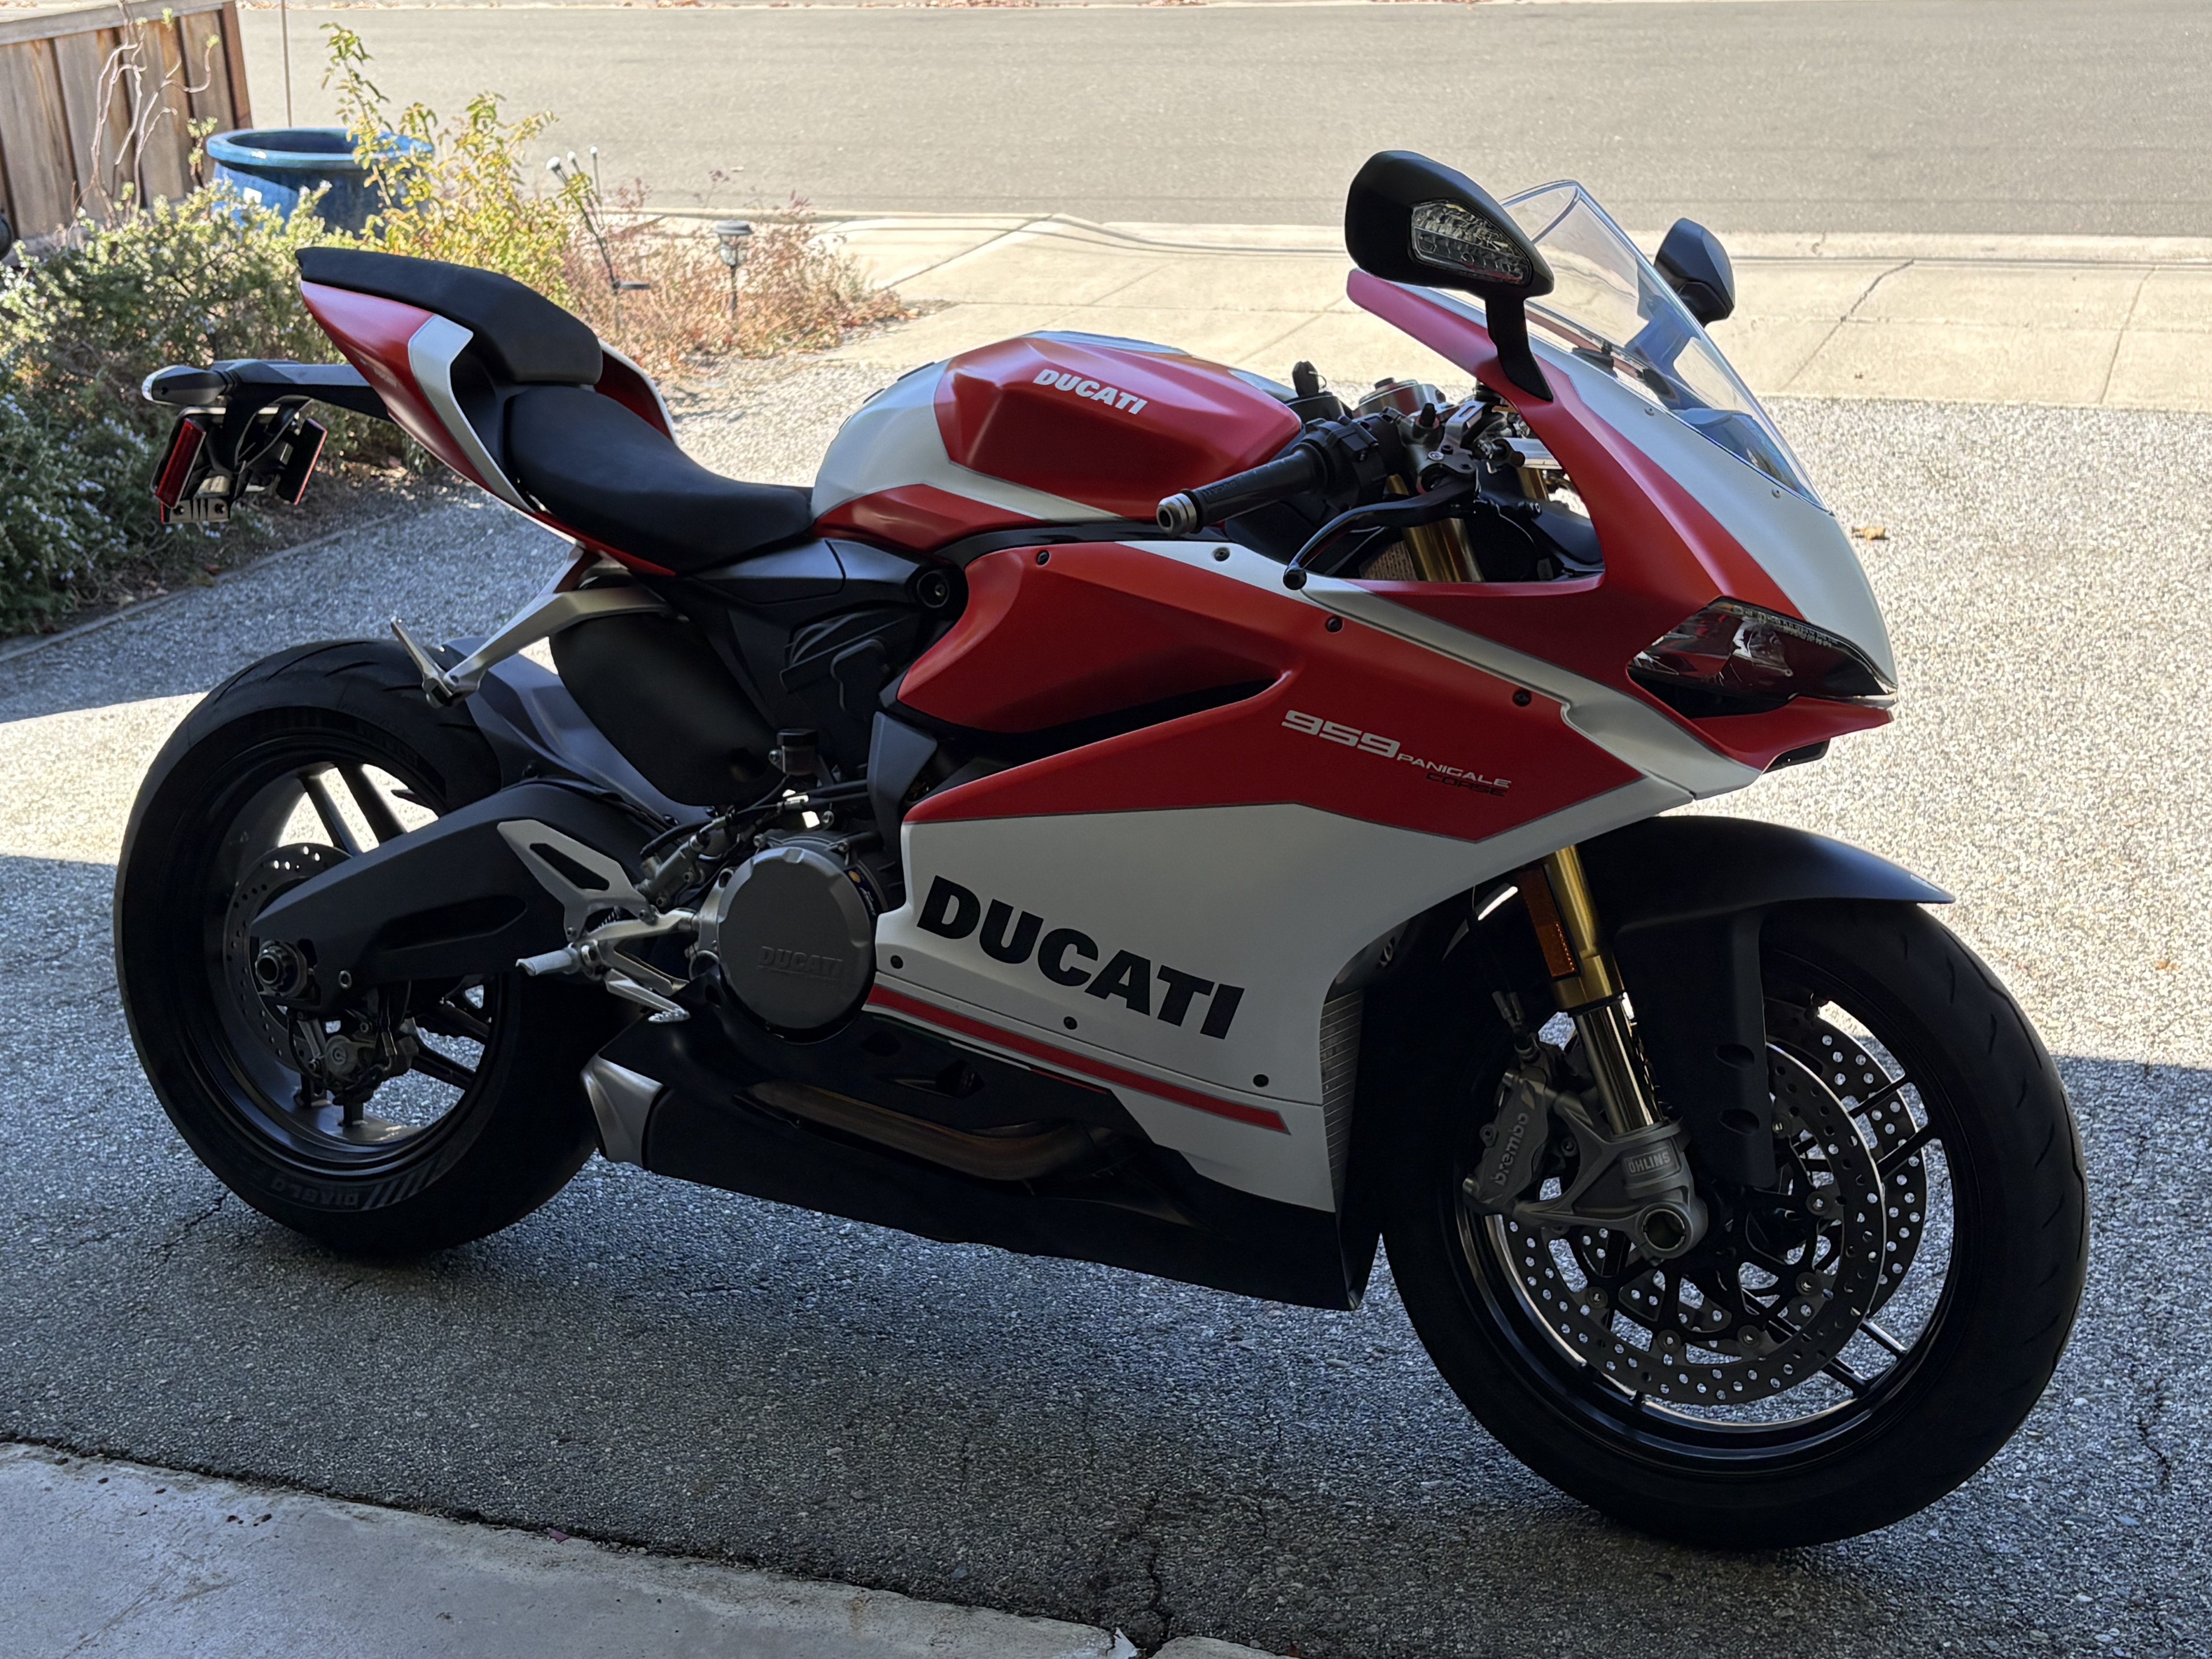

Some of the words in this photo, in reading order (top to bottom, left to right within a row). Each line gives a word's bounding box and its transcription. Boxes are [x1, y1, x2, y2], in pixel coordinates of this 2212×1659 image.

[1032, 369, 1148, 415] DUCATI
[1281, 709, 1401, 758] 959
[1396, 753, 1512, 788] PANIGALE
[1426, 772, 1508, 797] CORSE
[756, 946, 844, 981] DUCATI
[916, 875, 1245, 1040] DUCATI
[1489, 1112, 1529, 1186] brembo
[1628, 1150, 1672, 1174] ÖHLINS
[270, 1177, 359, 1206] DIABLO
